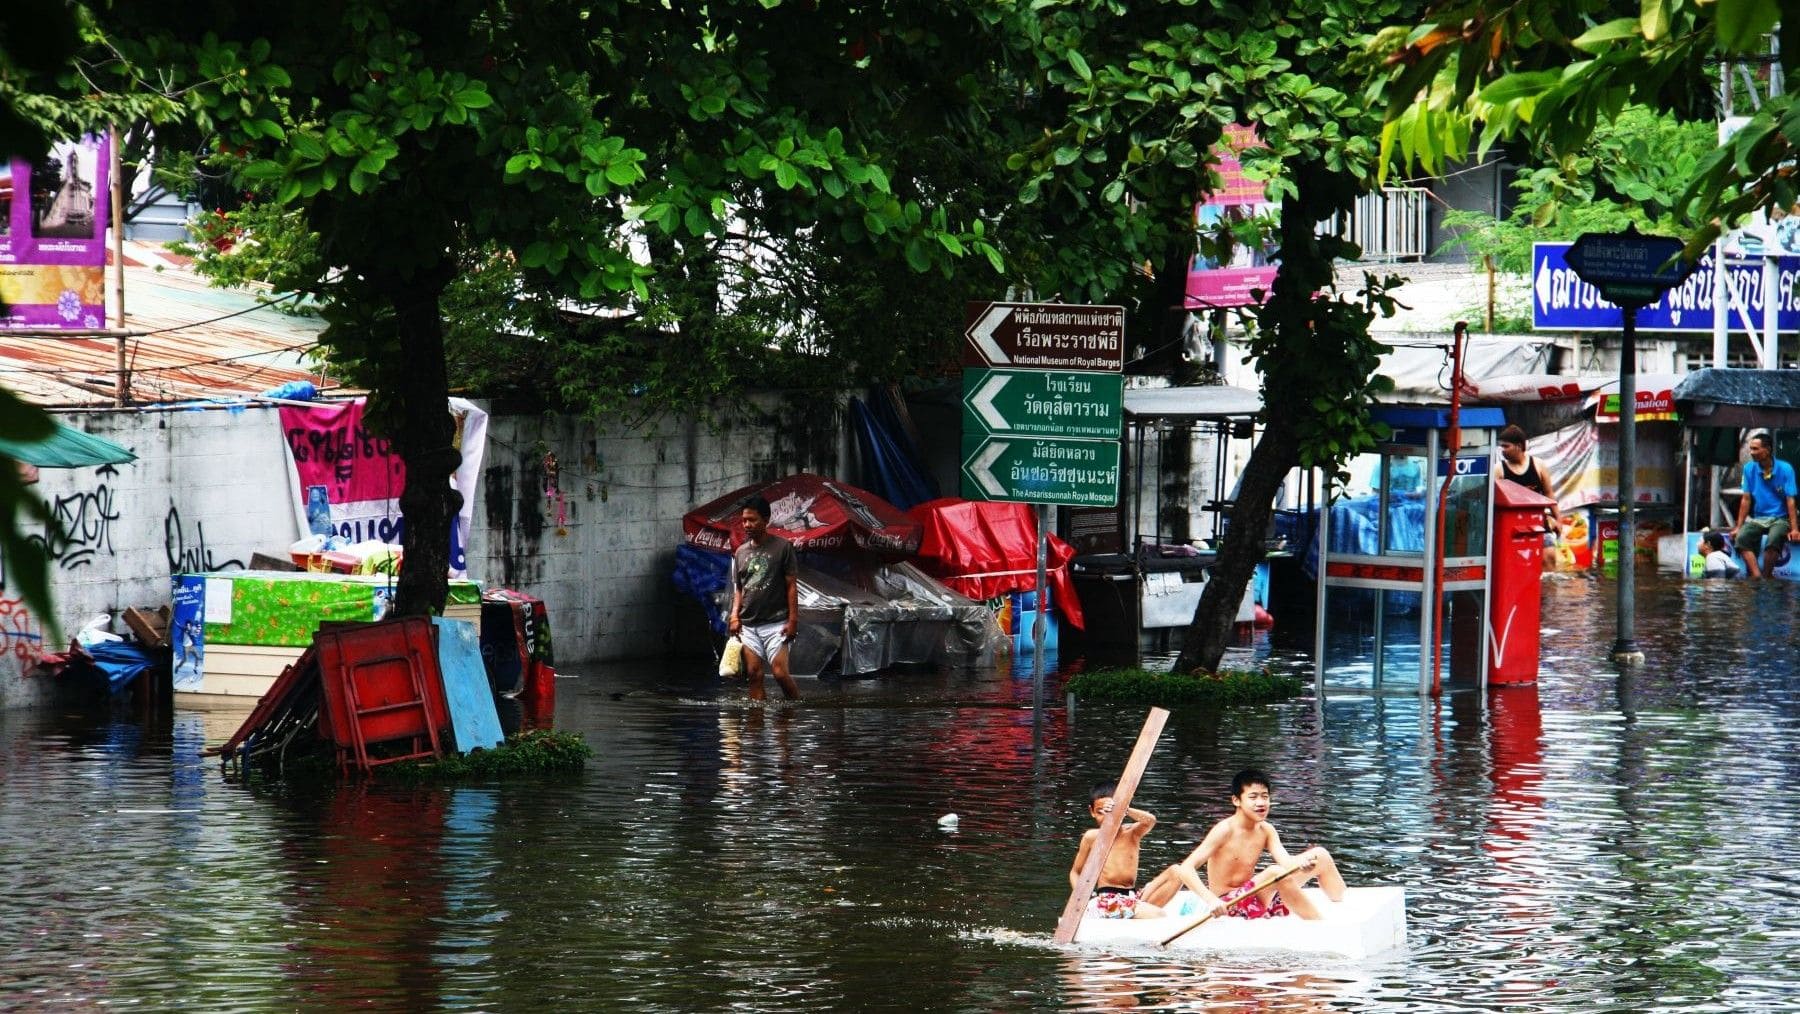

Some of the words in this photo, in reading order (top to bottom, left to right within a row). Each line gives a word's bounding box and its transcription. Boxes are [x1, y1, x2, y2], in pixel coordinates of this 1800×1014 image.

[1016, 326, 1118, 350] เรือพระราชพิธี
[1013, 354, 1041, 365] National
[1041, 355, 1069, 366] Museum
[1069, 356, 1077, 366] of
[1077, 357, 1097, 369] Royal
[1097, 357, 1121, 369] Barges
[1044, 372, 1092, 394] โรงเรียน
[1023, 393, 1109, 421] วัดดุสิตาราม
[1032, 441, 1096, 461] มัสยิดหลวง
[1448, 458, 1477, 474] OT
[1012, 488, 1024, 498] The
[1088, 492, 1114, 504] Mosque
